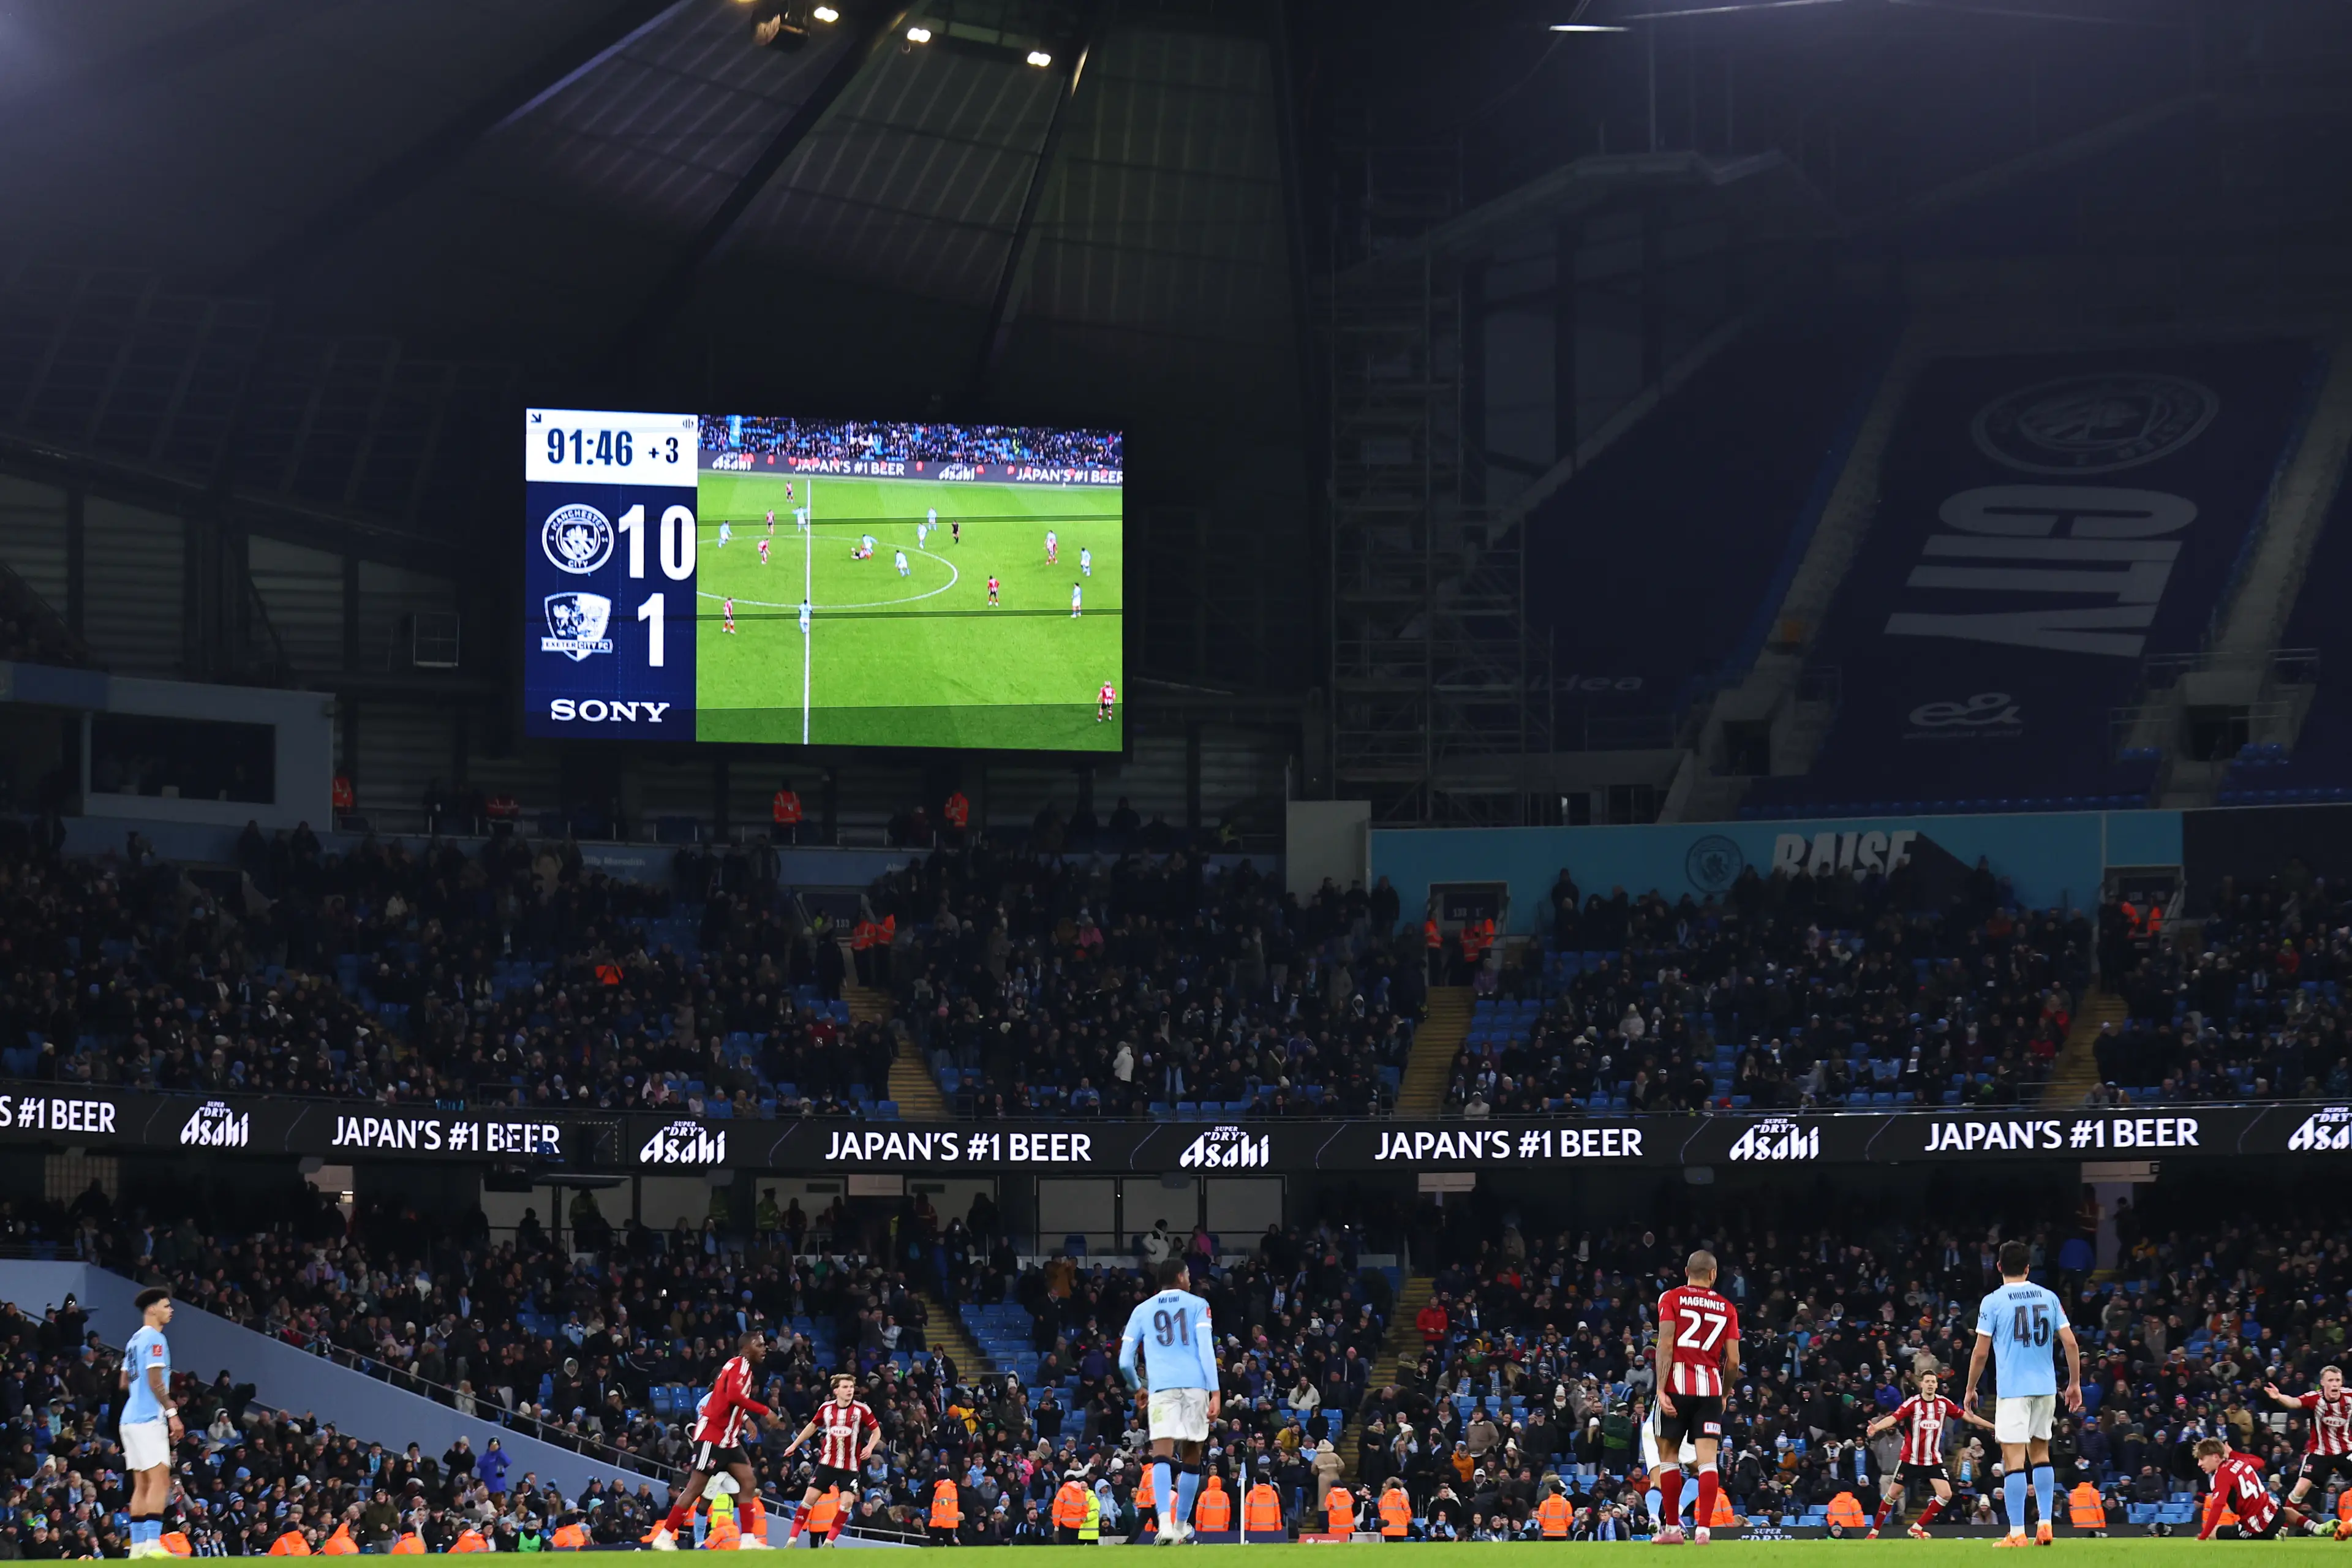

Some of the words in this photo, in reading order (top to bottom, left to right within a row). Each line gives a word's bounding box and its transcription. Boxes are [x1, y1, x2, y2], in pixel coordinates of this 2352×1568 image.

[547, 428, 633, 466] 91:46
[854, 461, 868, 475] #1
[1016, 462, 1072, 483] JAPAN'S
[1074, 470, 1088, 483] #1
[551, 509, 606, 533] MANCHESTER
[618, 503, 696, 581] 10
[567, 560, 589, 568] CITY
[578, 641, 597, 650] CITY
[638, 592, 665, 667] 1
[551, 698, 670, 722] SONY
[18, 1097, 45, 1129] #1
[51, 1099, 116, 1133] BEER
[180, 1109, 249, 1147] Asahi
[332, 1116, 441, 1150] JAPAN'S
[448, 1121, 478, 1151] #1
[487, 1123, 560, 1154] BEER
[639, 1129, 725, 1164] Asahi
[825, 1131, 959, 1161] JAPAN'S
[967, 1133, 1000, 1161] #1
[1009, 1133, 1091, 1161] BEER
[1180, 1134, 1269, 1167] Asahi
[1374, 1130, 1510, 1160] JAPAN'S
[1518, 1130, 1551, 1158] #1
[1561, 1128, 1643, 1157] BEER
[1729, 1126, 1819, 1161] Asahi
[1924, 1120, 2062, 1151] JAPAN'S
[2069, 1119, 2105, 1148] #1
[2113, 1118, 2199, 1147] BEER
[1679, 1295, 1726, 1313] MAGENNIS
[2008, 1289, 2043, 1301] KHUSANOV
[1154, 1307, 1190, 1347] 91
[1677, 1308, 1727, 1352] 27
[2013, 1303, 2049, 1348] 45
